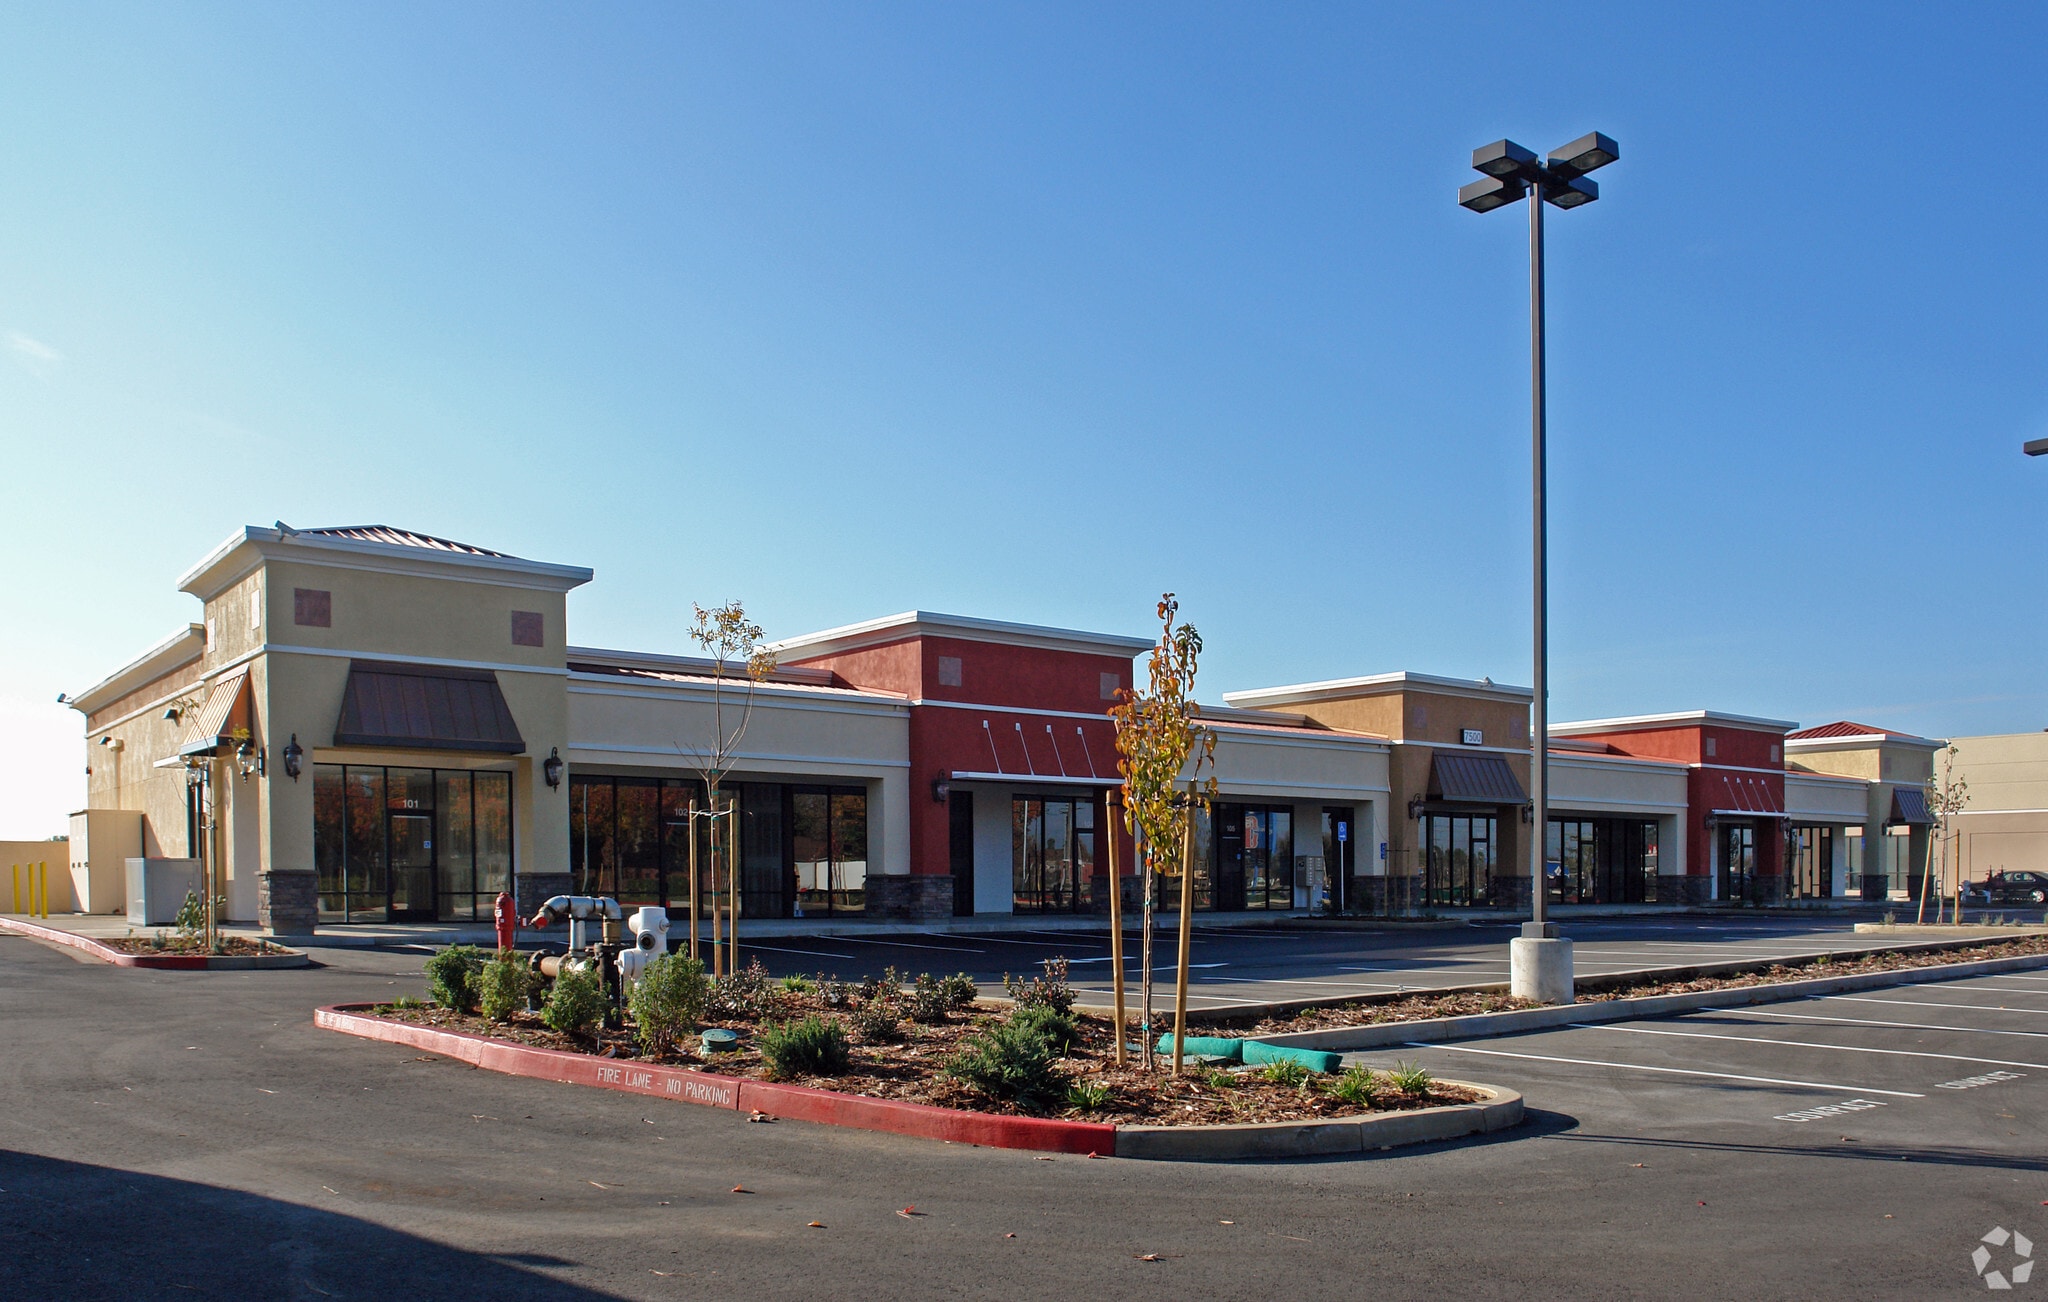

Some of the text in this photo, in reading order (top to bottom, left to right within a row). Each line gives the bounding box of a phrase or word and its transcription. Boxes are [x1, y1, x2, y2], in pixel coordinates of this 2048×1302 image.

[1463, 731, 1481, 742] 7500
[402, 799, 419, 809] 101
[674, 807, 689, 817] 102
[597, 1067, 622, 1084] FIRE
[625, 1071, 653, 1090] LANE
[666, 1078, 682, 1095] NO
[685, 1081, 730, 1105] PARKING
[1773, 1098, 1888, 1122] COMPACT
